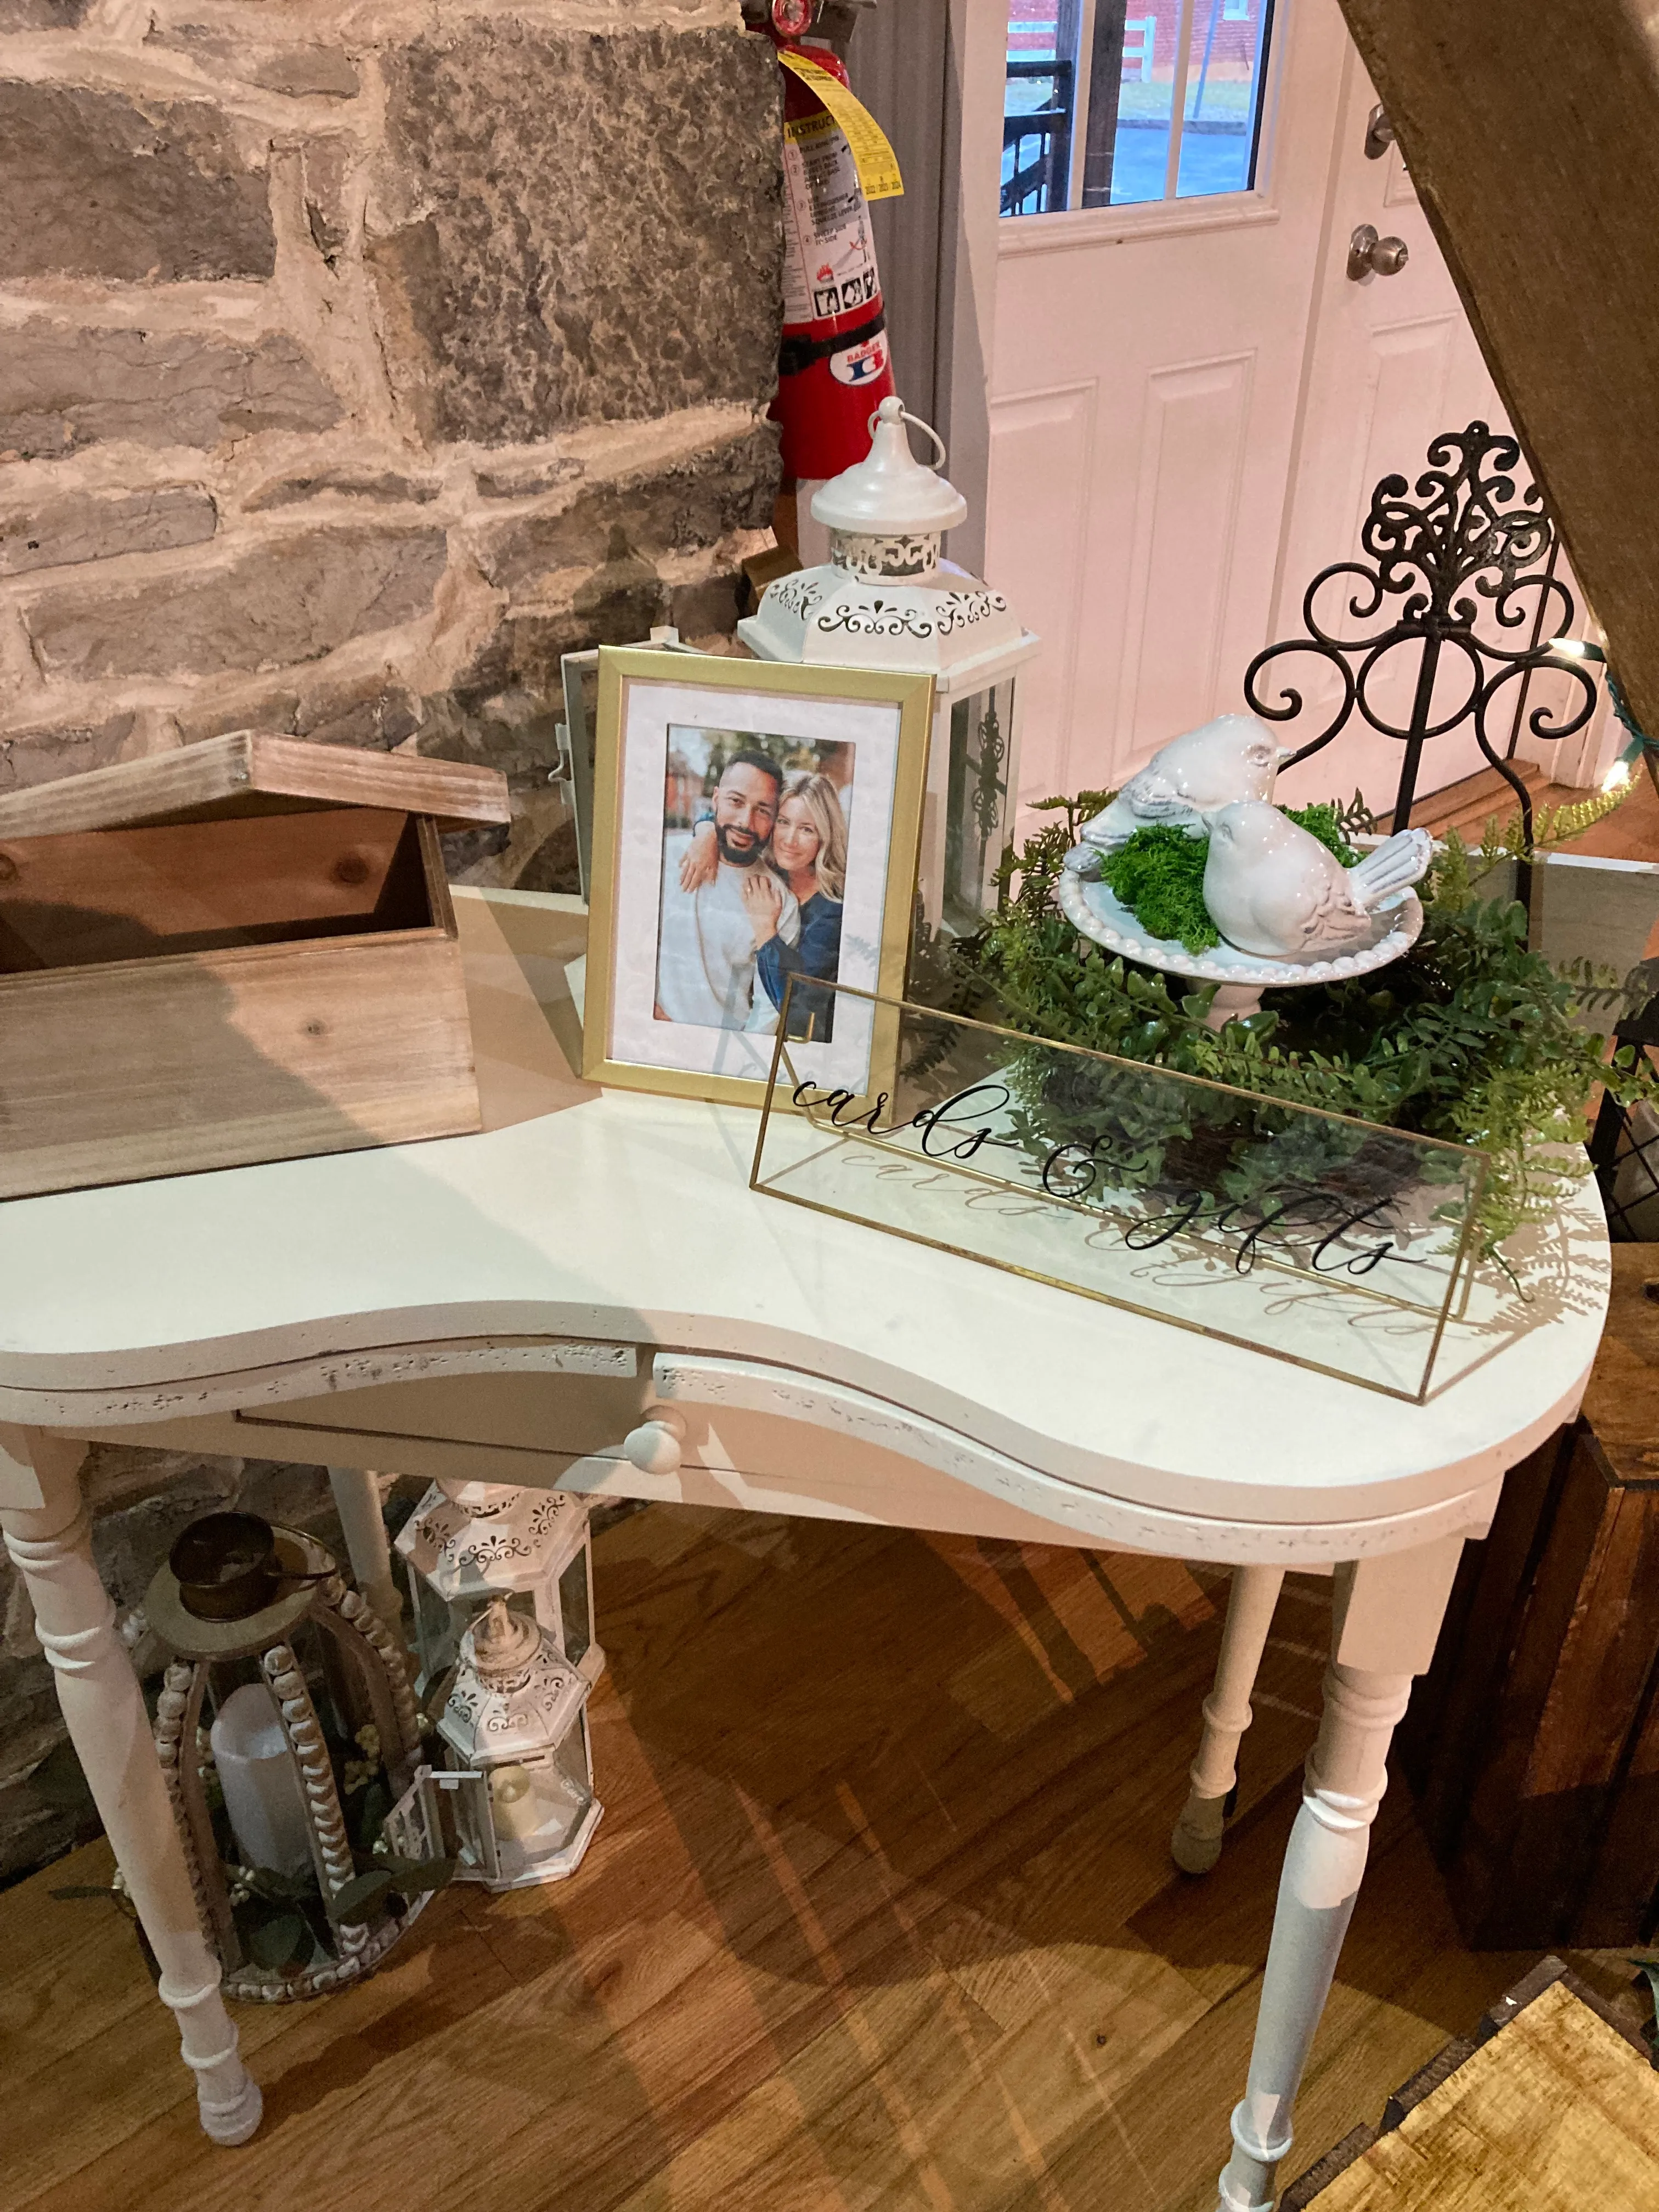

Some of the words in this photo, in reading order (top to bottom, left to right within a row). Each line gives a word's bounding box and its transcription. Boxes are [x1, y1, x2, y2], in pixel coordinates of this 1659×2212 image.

[825, 235, 837, 243] SIDE
[847, 341, 880, 363] BADGER
[792, 1081, 1019, 1159] cards
[1042, 1135, 1148, 1198] &
[1125, 1184, 1427, 1275] gifts
